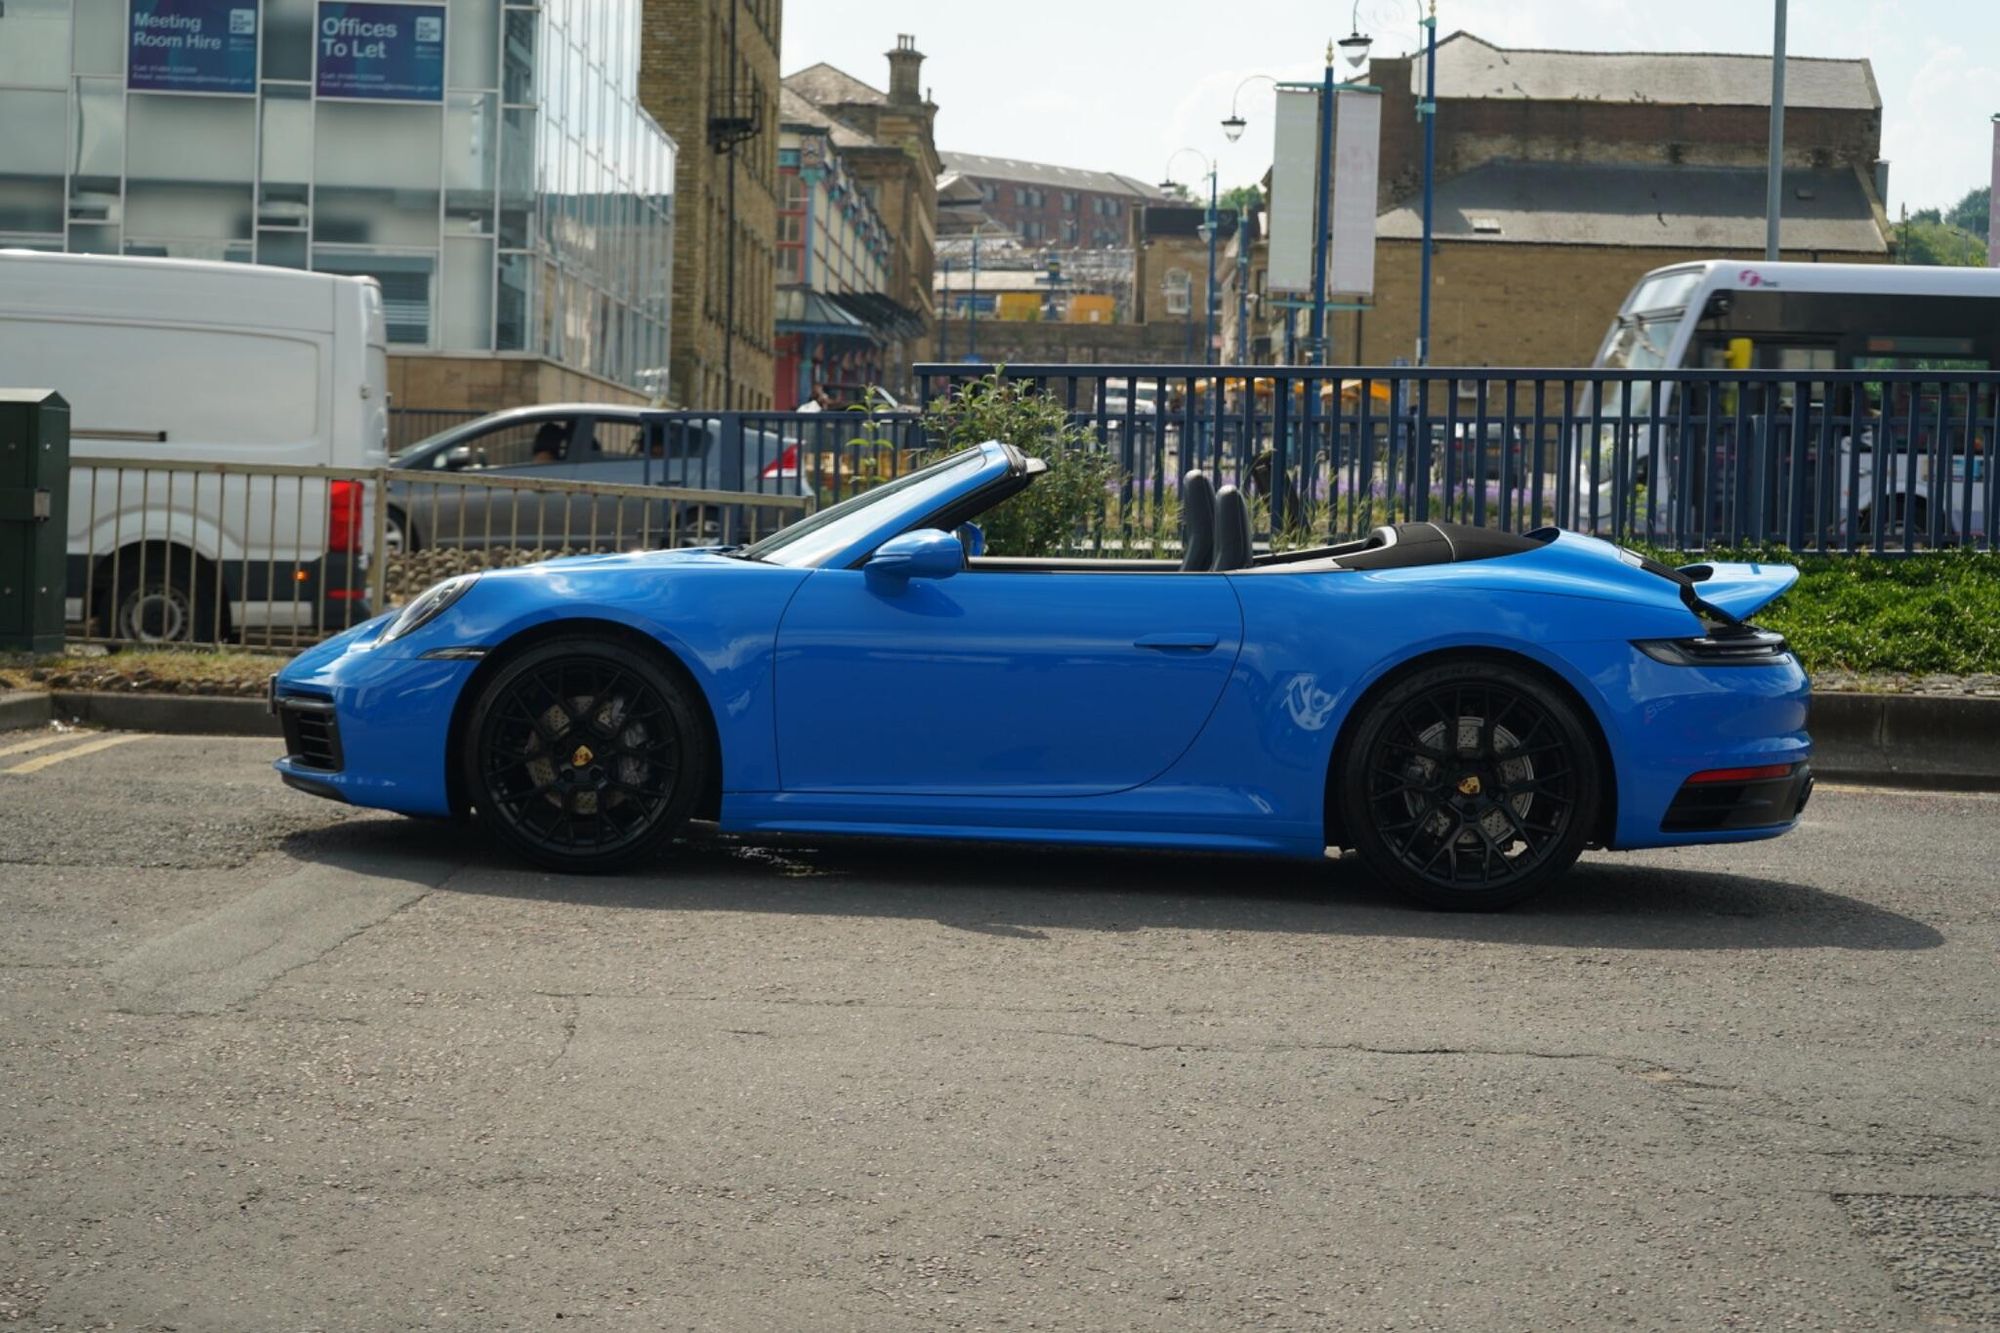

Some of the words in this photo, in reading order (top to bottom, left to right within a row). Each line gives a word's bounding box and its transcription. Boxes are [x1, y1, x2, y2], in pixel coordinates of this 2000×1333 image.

[134, 12, 202, 32] Meeting
[322, 17, 398, 38] Offices
[133, 31, 182, 48] Room
[186, 33, 222, 50] Hire
[322, 38, 348, 57] To
[352, 40, 387, 59] Let
